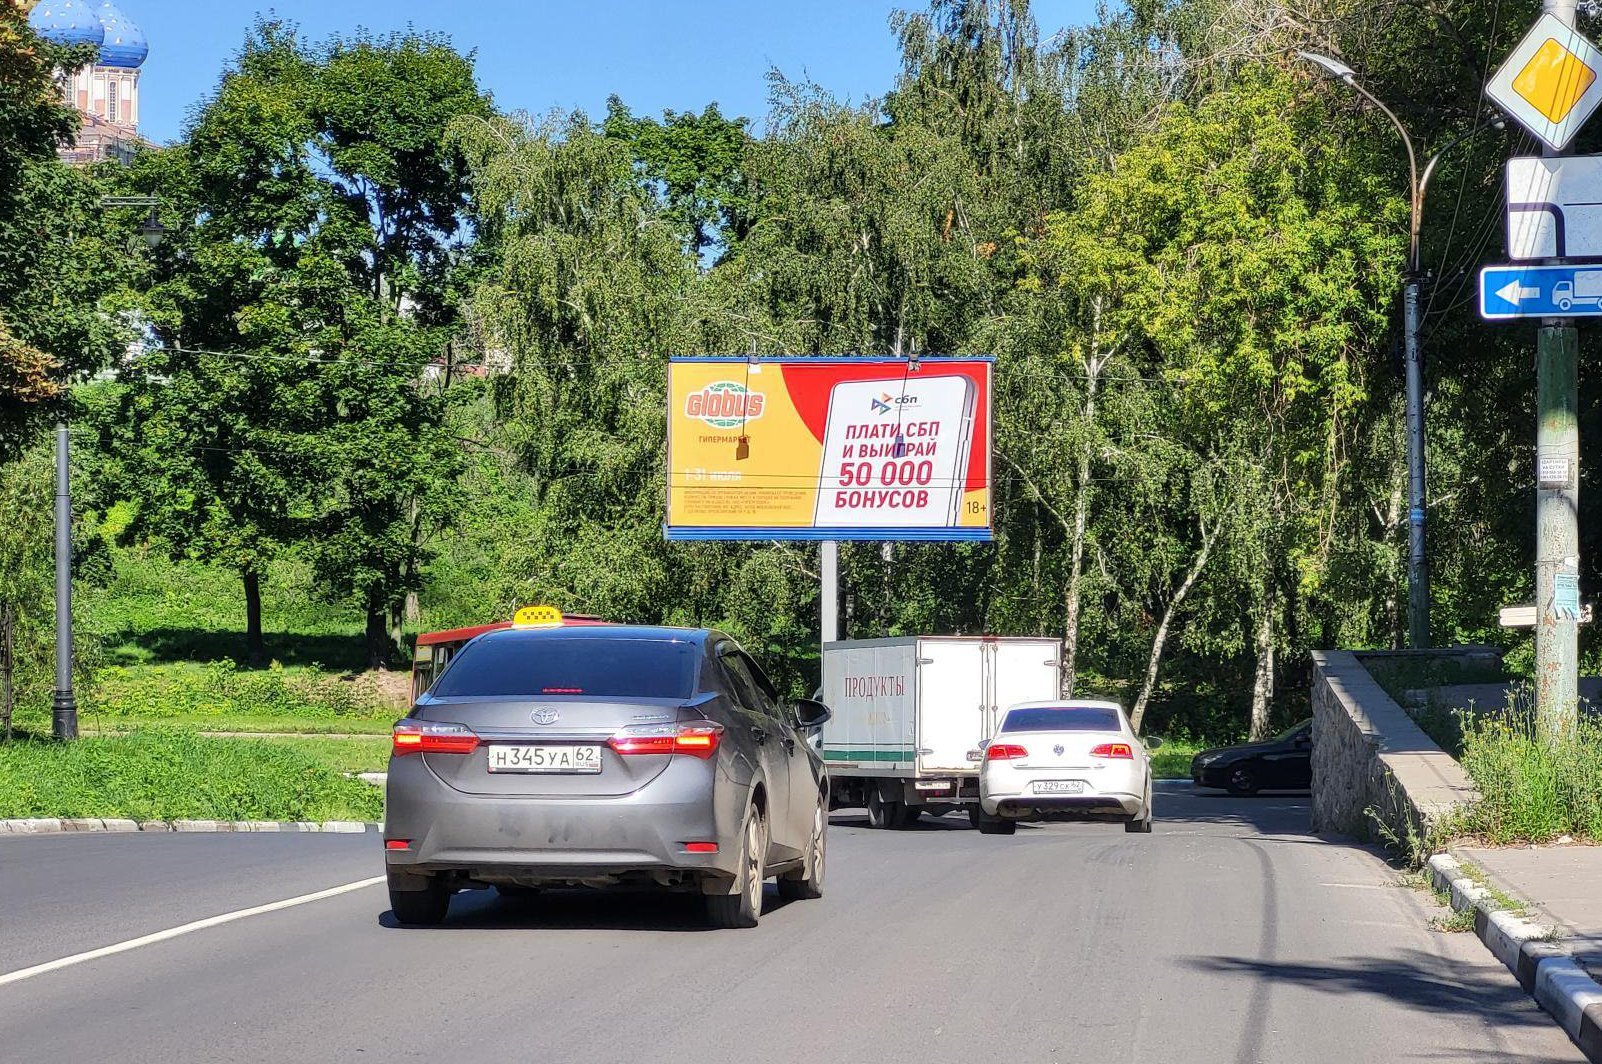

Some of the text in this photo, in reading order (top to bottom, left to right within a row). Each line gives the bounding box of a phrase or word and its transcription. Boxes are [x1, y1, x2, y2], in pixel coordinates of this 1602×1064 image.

[686, 388, 764, 417] Globus
[845, 421, 940, 440] ПЛАТИ СБП
[842, 438, 938, 458] И ВЫИГРАЙ
[838, 460, 933, 487] 50 000
[835, 490, 929, 508] БОНУСОВ
[966, 501, 987, 514] 18+
[844, 675, 905, 702] ПРОДУКТЫ
